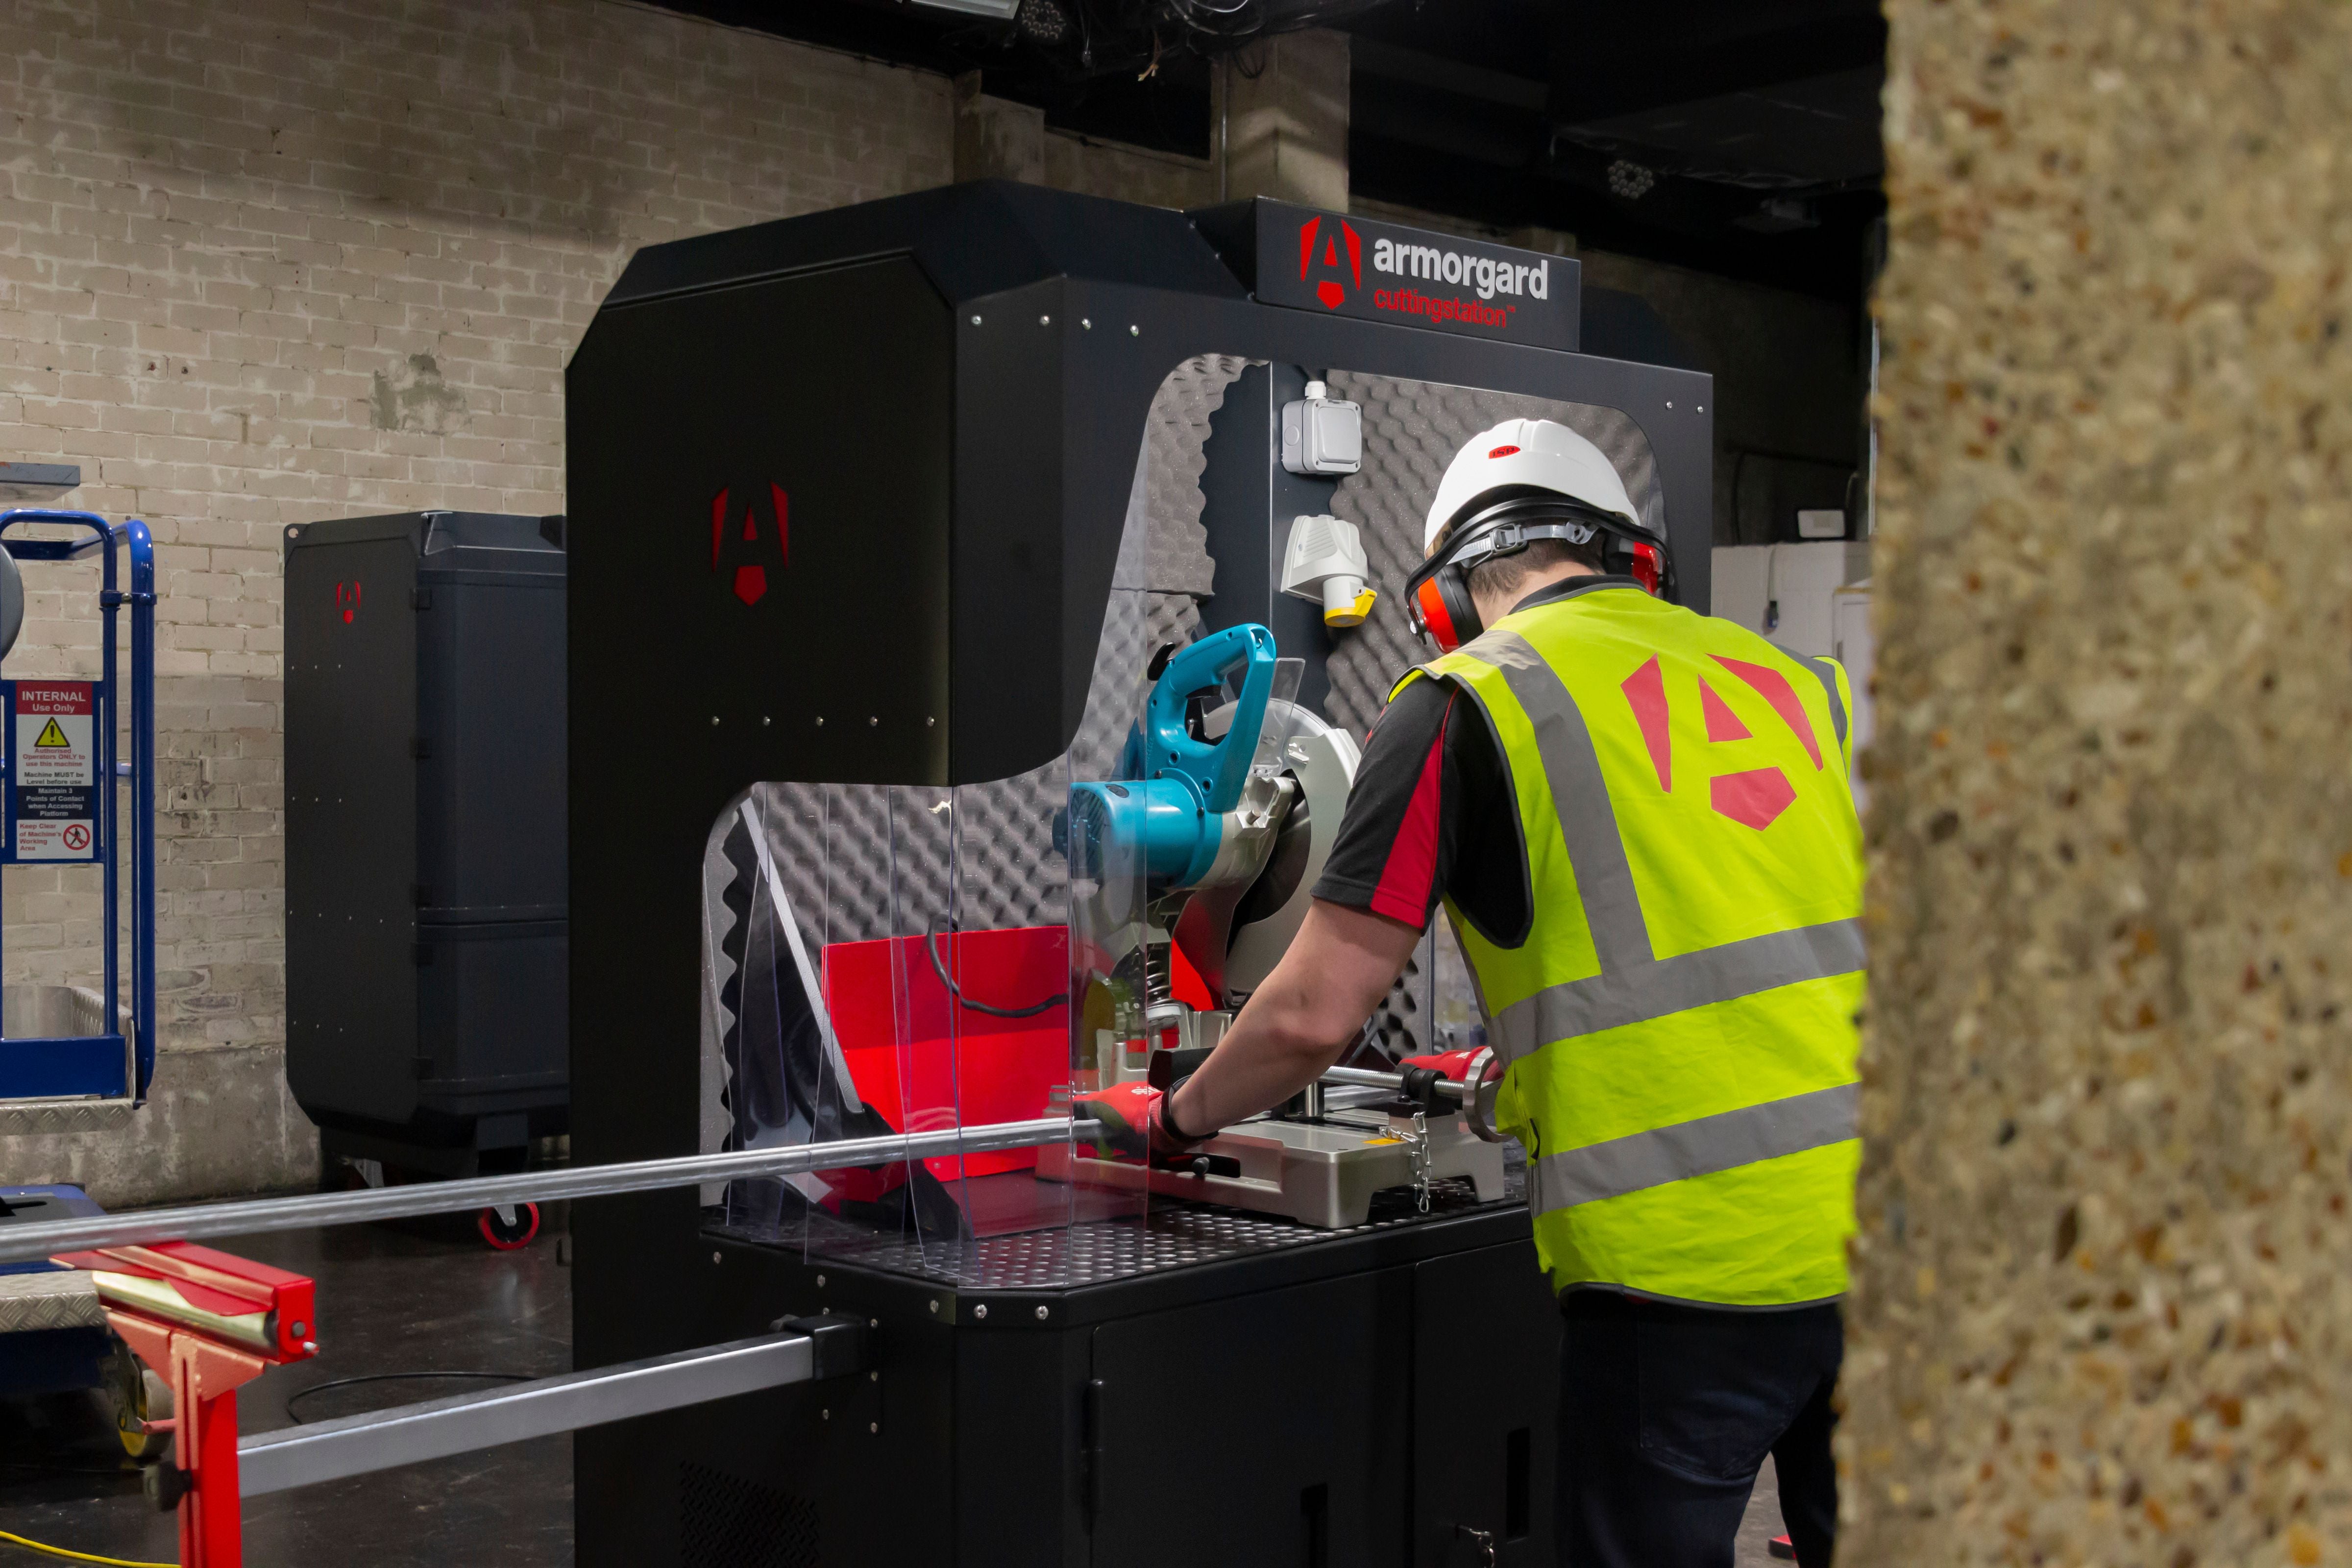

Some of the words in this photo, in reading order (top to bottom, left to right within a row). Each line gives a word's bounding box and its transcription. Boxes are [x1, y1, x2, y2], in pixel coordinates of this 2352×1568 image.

[1373, 239, 1548, 299] armorgard
[1374, 288, 1506, 327] cuttingstation
[22, 691, 86, 702] INTERNAL
[53, 704, 74, 713] Only
